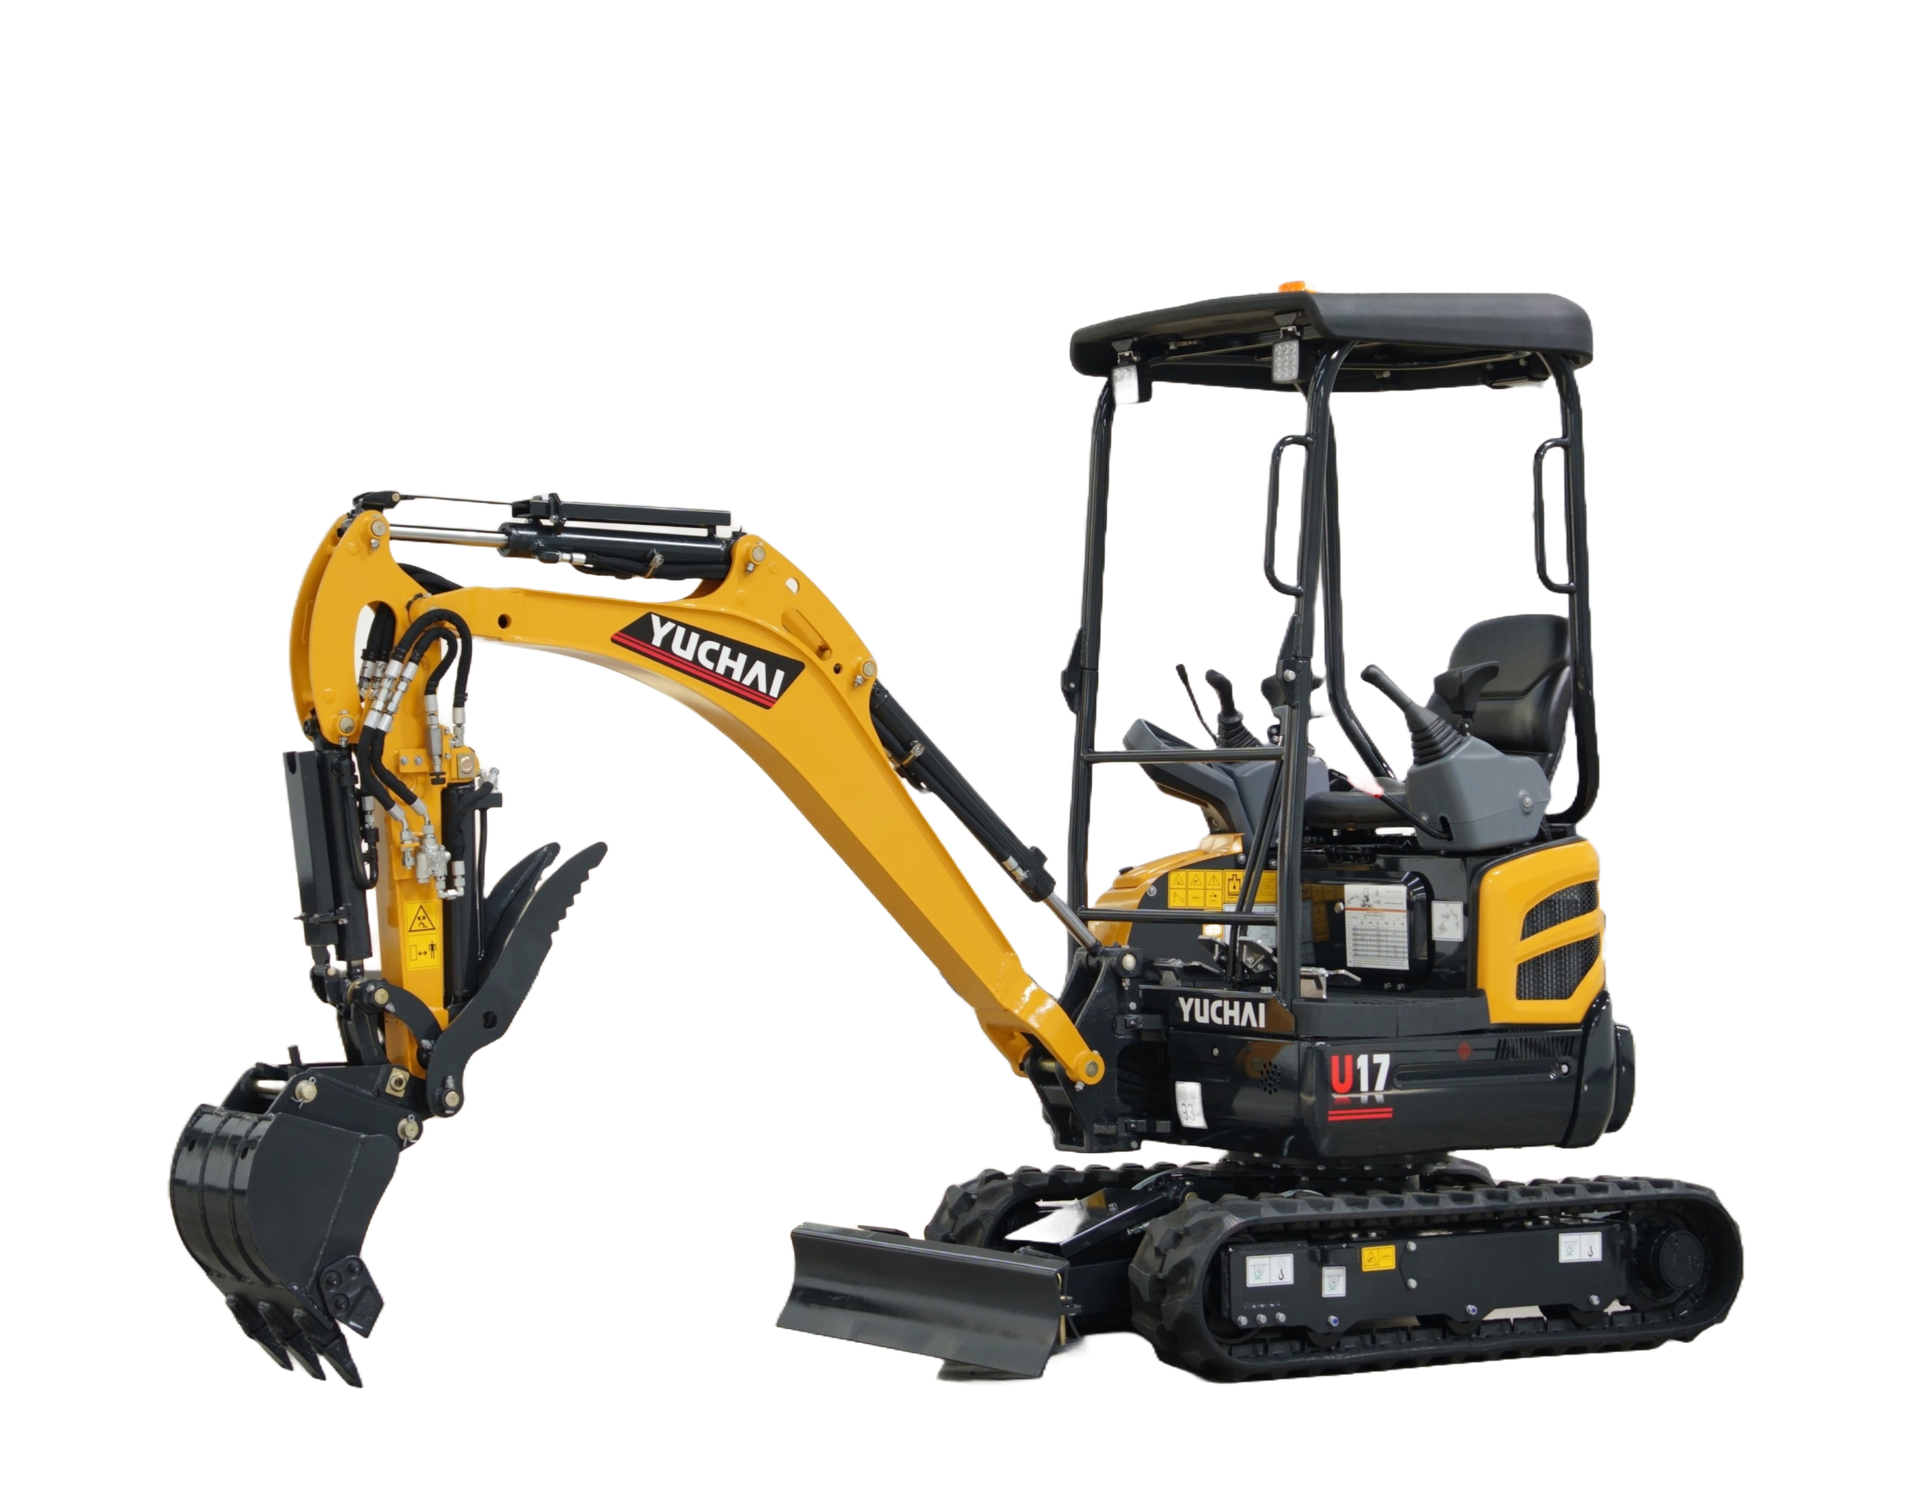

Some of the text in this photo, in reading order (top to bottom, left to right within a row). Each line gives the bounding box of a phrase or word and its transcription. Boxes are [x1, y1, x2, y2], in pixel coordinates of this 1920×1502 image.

[651, 613, 785, 699] YUCHAI
[1178, 996, 1266, 1029] YUCHAI
[1330, 1053, 1391, 1095] U17
[1181, 1103, 1196, 1121] 93
